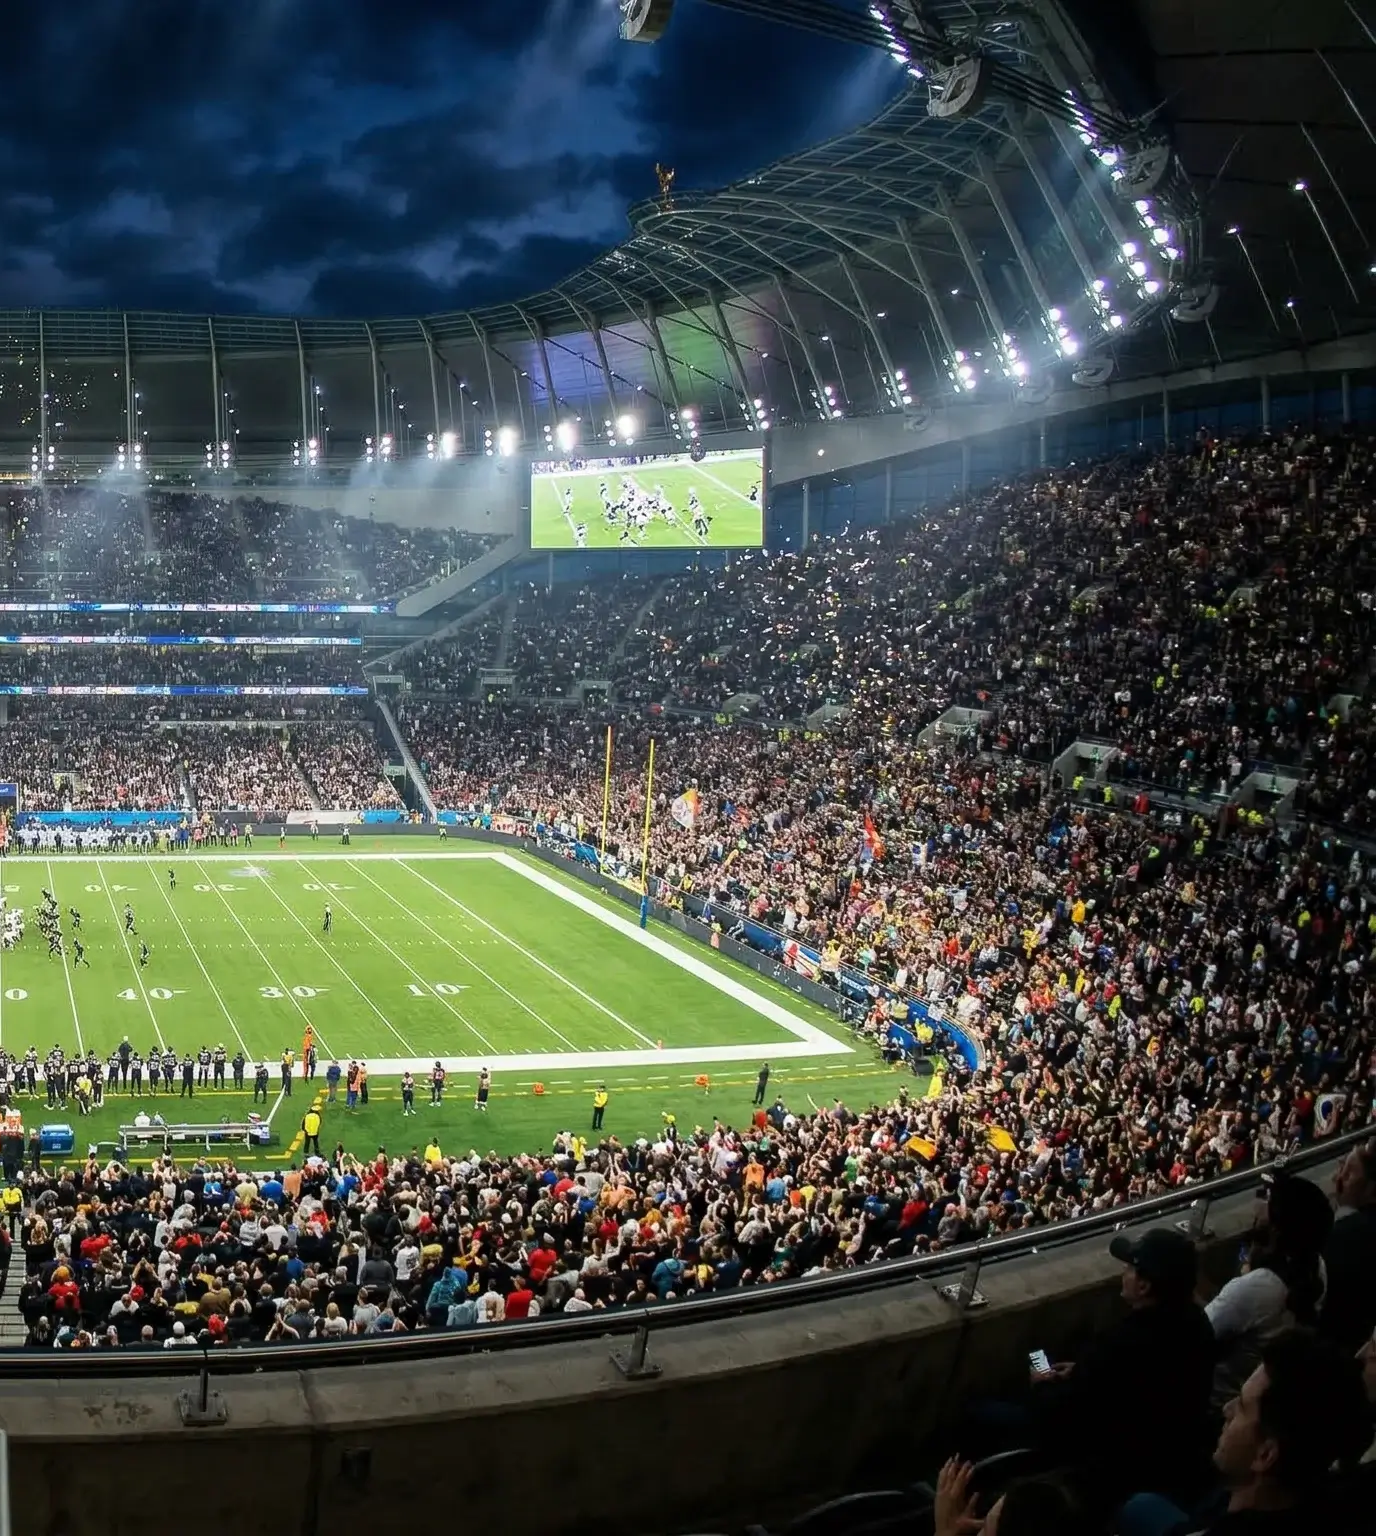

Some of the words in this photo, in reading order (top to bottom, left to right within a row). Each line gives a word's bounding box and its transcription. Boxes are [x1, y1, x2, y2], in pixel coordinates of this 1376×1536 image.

[116, 987, 173, 1000] 40
[258, 985, 317, 998] 30
[403, 983, 461, 997] 10
